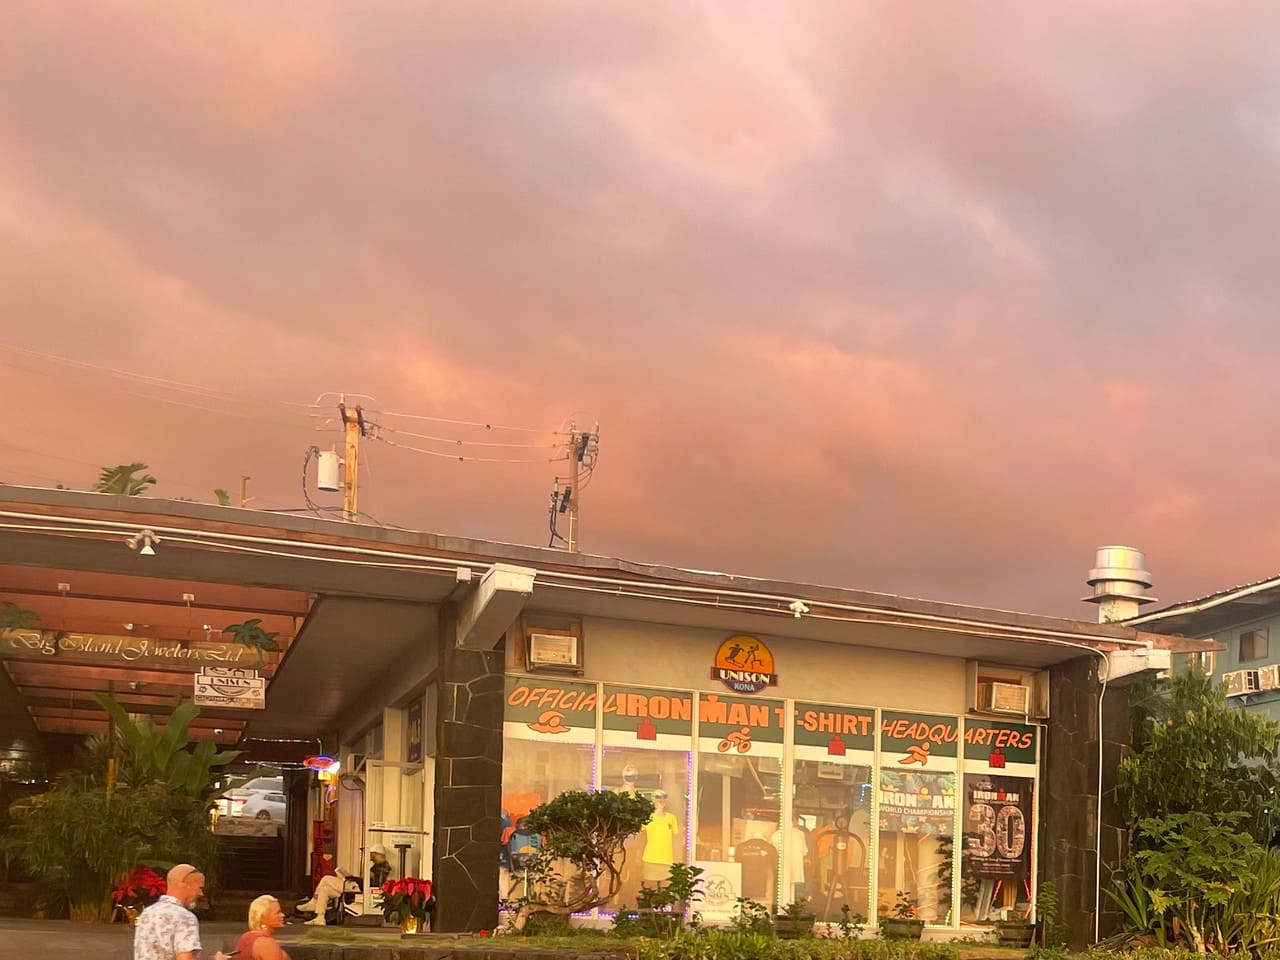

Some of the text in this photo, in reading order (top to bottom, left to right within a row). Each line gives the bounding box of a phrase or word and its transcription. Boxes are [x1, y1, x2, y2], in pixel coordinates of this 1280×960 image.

[10, 633, 56, 655] Big
[59, 635, 123, 655] Island
[204, 645, 243, 662] Ltd
[719, 669, 770, 684] UNISON
[734, 682, 755, 692] KONA
[507, 686, 618, 713] OFFICIAL
[872, 719, 1033, 749] HEADQUARTERS
[880, 806, 954, 817] WORLD CHAMPIONSHIP
[967, 803, 1026, 859] 30
